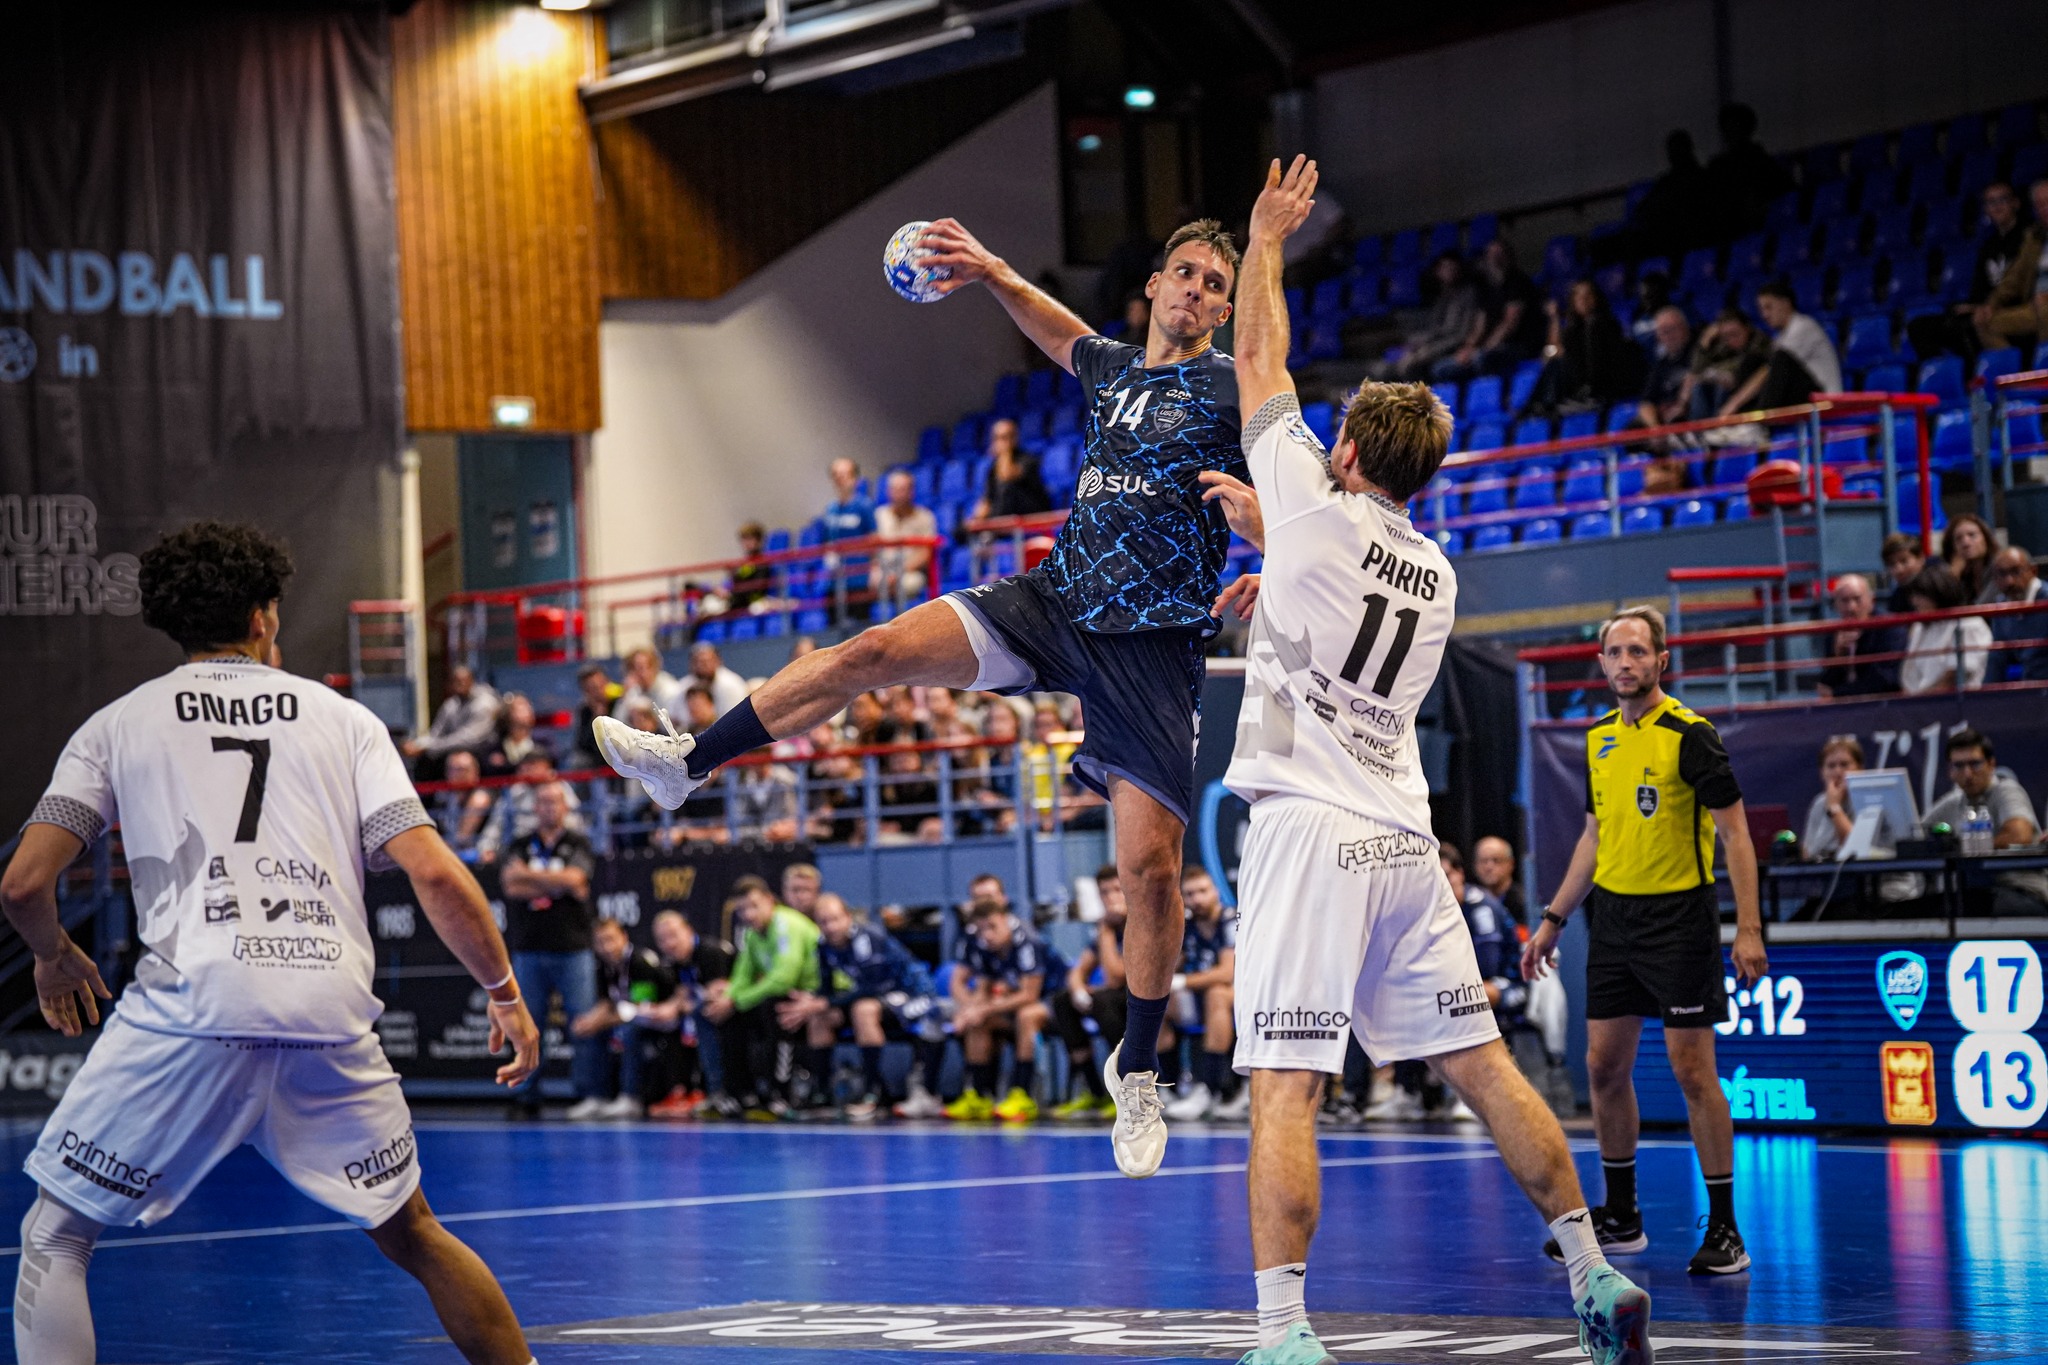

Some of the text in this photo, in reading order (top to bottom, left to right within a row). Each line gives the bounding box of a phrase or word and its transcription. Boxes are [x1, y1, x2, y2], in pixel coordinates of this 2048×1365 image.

[1106, 387, 1153, 431] 14
[0, 494, 98, 555] UR
[1361, 540, 1439, 602] PARIS
[1339, 592, 1420, 699] 11
[175, 691, 298, 726] GNAGO
[211, 736, 270, 843] 7
[1338, 831, 1431, 871] FESTYLAND
[233, 935, 342, 961] FESTYLAND
[1437, 979, 1483, 1015] print
[1964, 956, 2029, 1014] 17
[1970, 1050, 2037, 1111] 13
[770, 1304, 1260, 1320] AINT-GOBAIN
[559, 1316, 1580, 1355] weber
